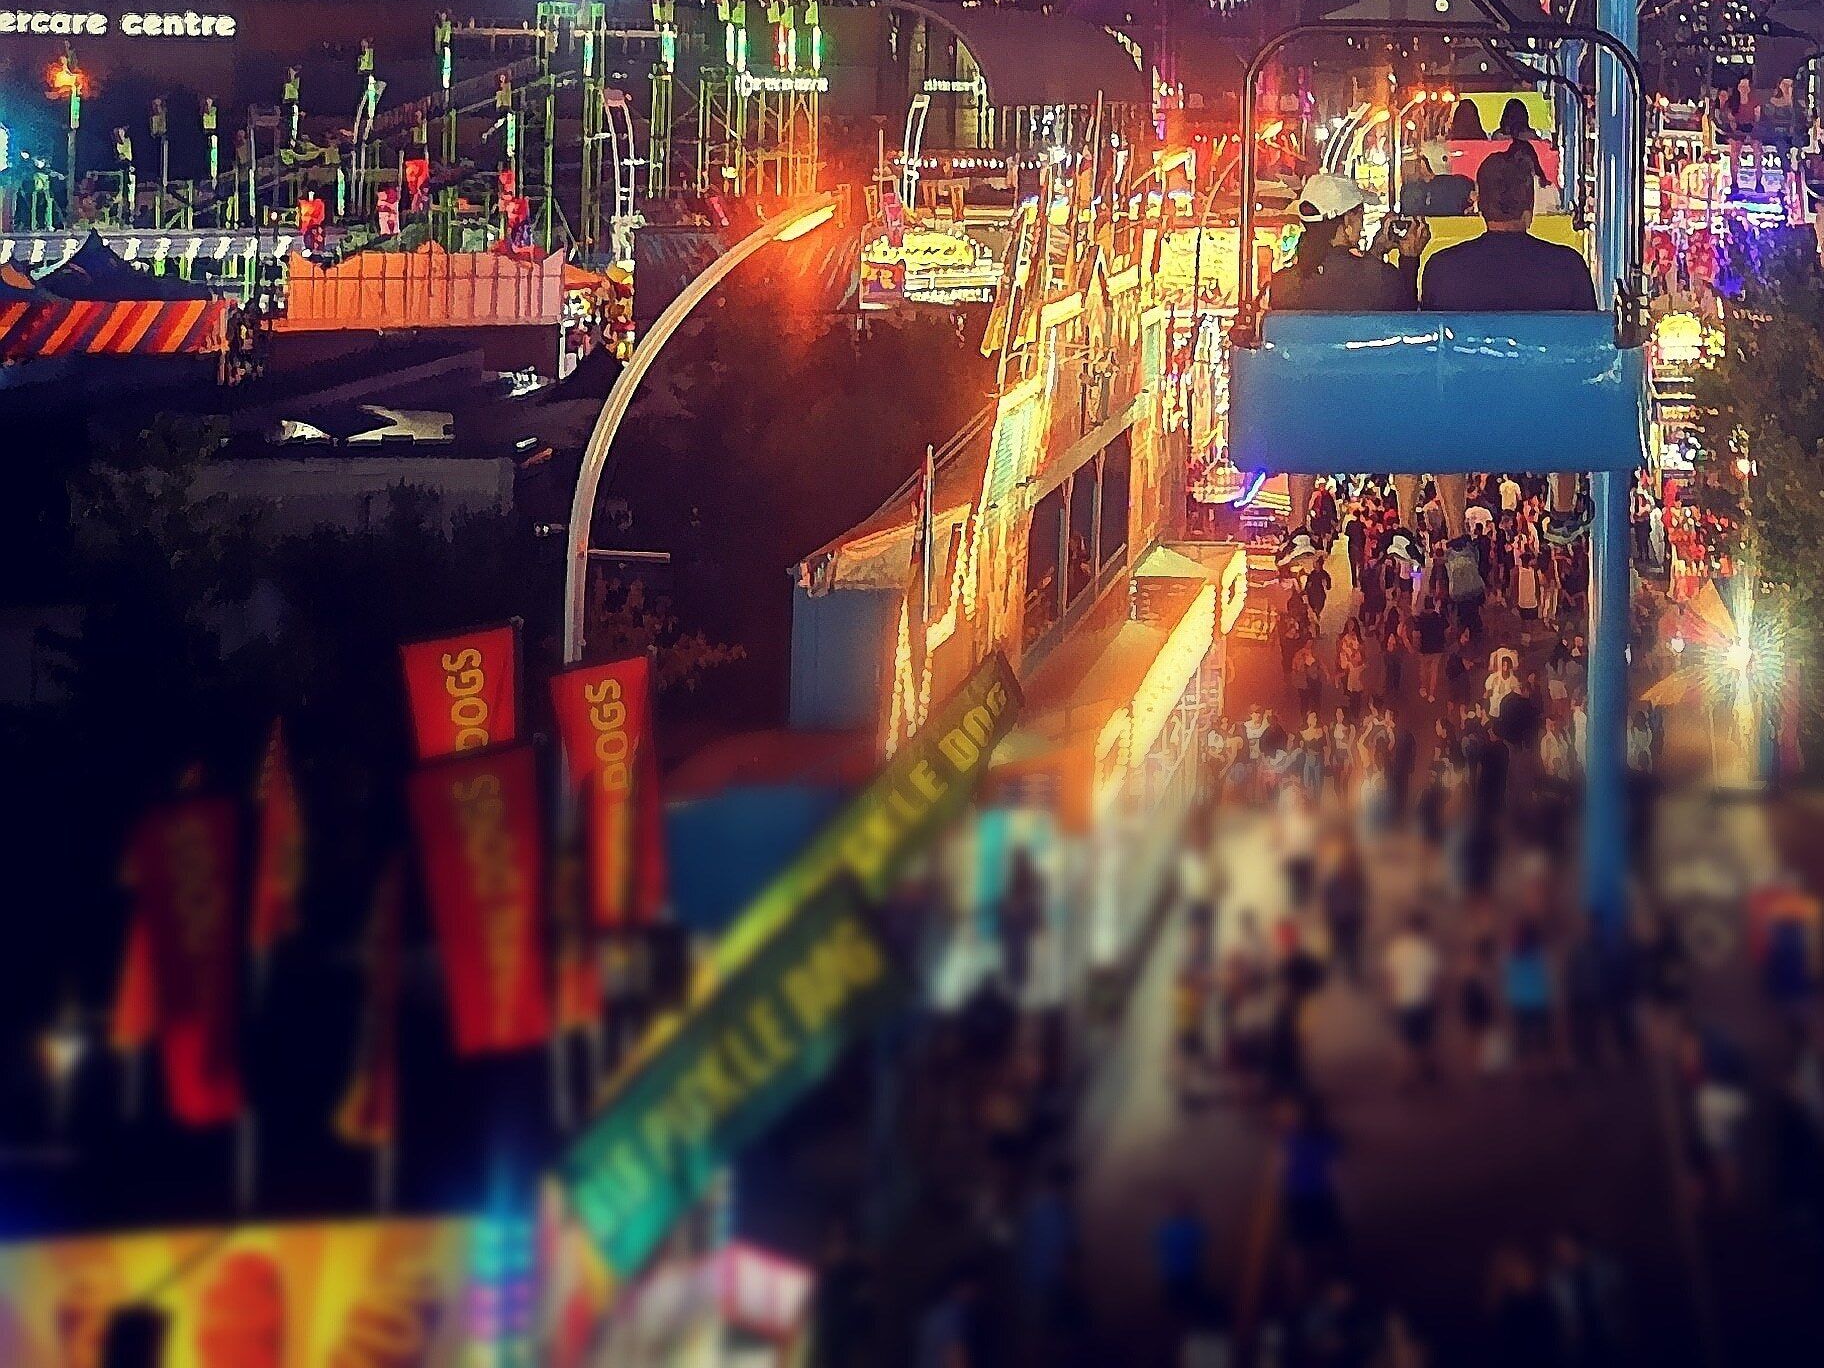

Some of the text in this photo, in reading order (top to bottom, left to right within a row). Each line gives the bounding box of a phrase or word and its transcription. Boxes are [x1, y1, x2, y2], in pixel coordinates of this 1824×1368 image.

[119, 9, 237, 37] centre
[442, 648, 489, 752] DOGS
[584, 678, 628, 792] DOGS
